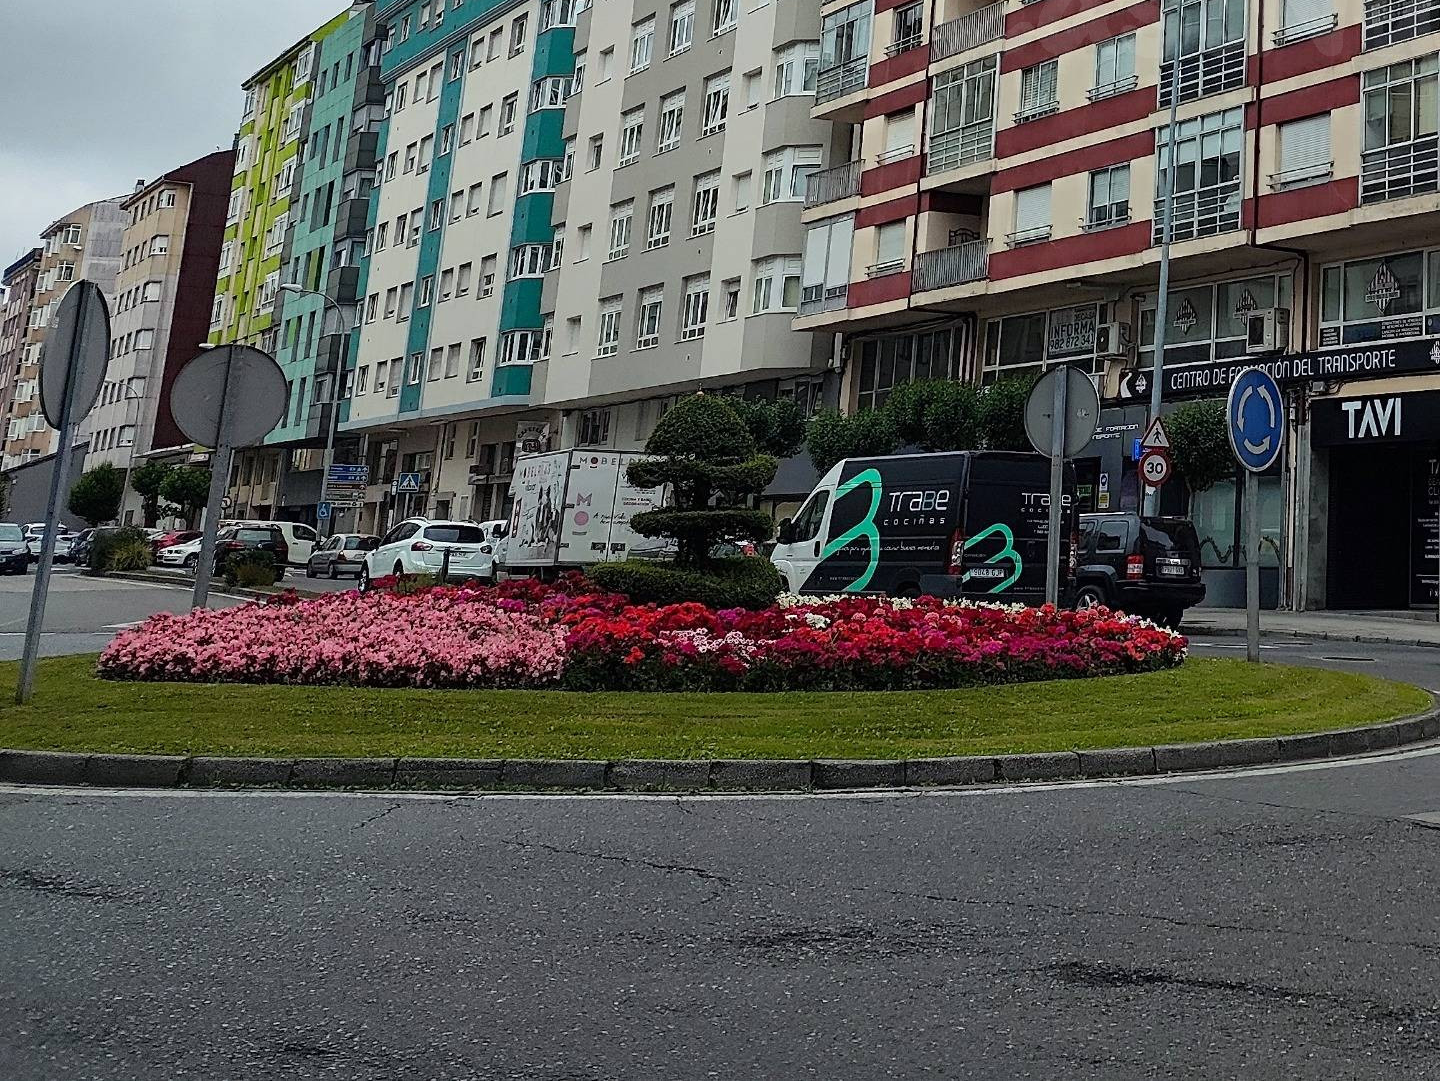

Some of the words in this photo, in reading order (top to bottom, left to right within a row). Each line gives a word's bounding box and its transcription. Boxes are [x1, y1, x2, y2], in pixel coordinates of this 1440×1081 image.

[1051, 320, 1096, 339] INFORMA
[1066, 335, 1080, 349] 872
[1081, 333, 1095, 346] 341
[1171, 369, 1210, 390] CENTRO
[1213, 366, 1227, 386] DE
[1293, 359, 1314, 377] DEL
[1317, 349, 1396, 373] TRANSPORTE
[1341, 397, 1402, 439] TAVI
[1146, 462, 1164, 475] 30
[883, 514, 946, 526] cociñas
